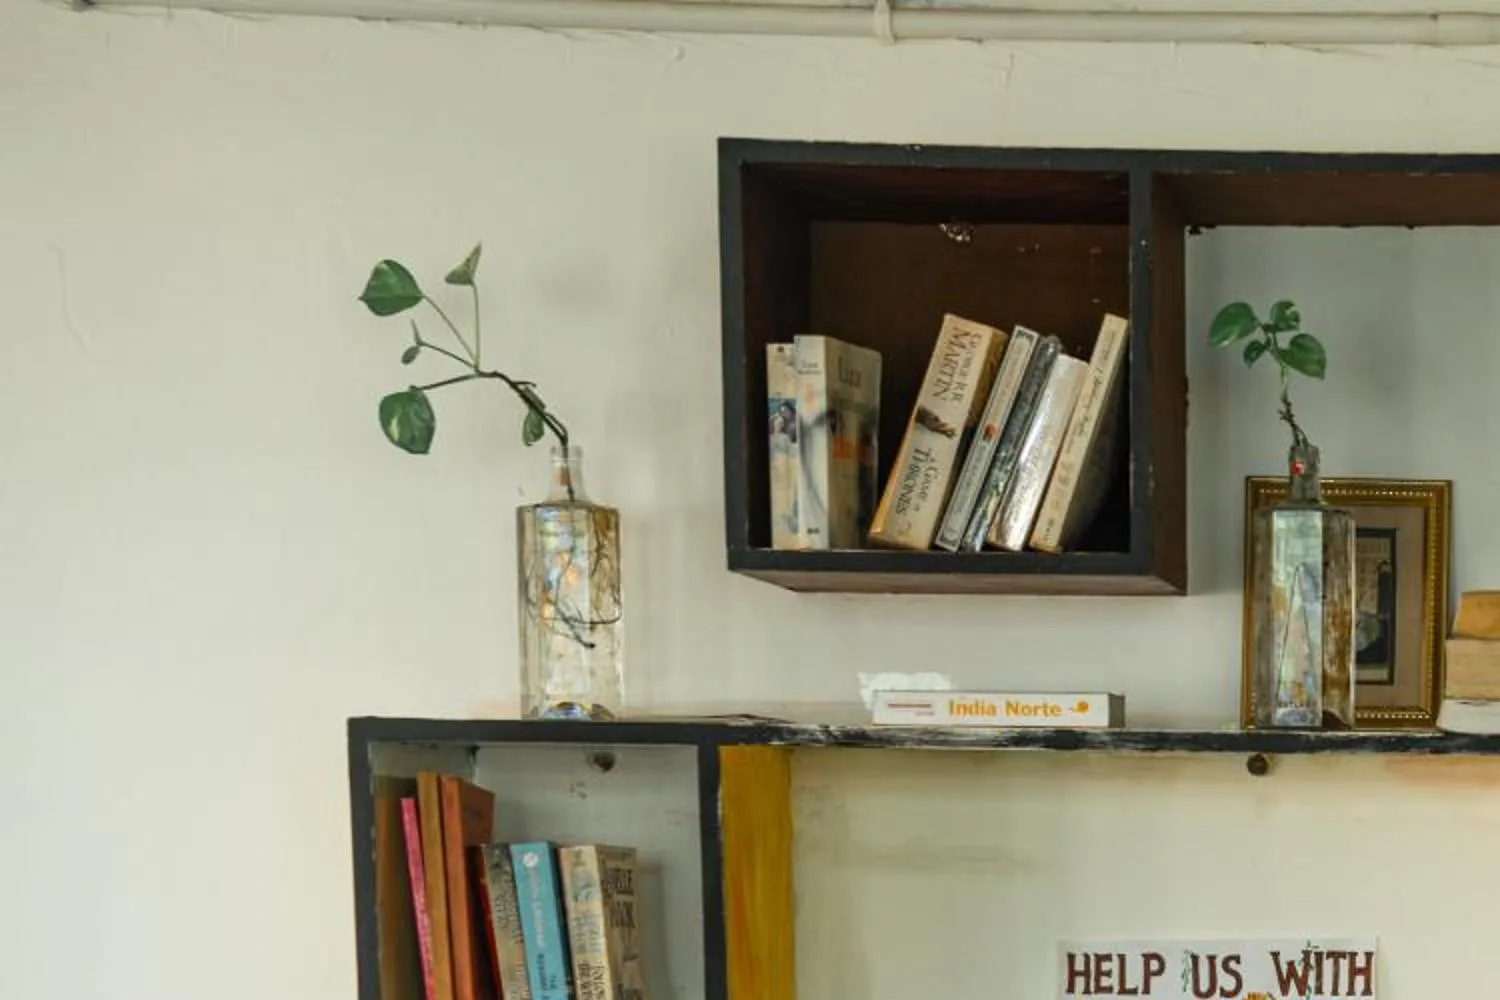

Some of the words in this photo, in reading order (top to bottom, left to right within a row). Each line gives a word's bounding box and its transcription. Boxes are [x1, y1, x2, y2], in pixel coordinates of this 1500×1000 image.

[933, 326, 971, 402] MARTIN
[949, 700, 997, 717] India
[1005, 700, 1063, 717] Norte
[1066, 952, 1165, 995] HELP
[1191, 952, 1243, 999] US
[1270, 949, 1374, 997] WITH
